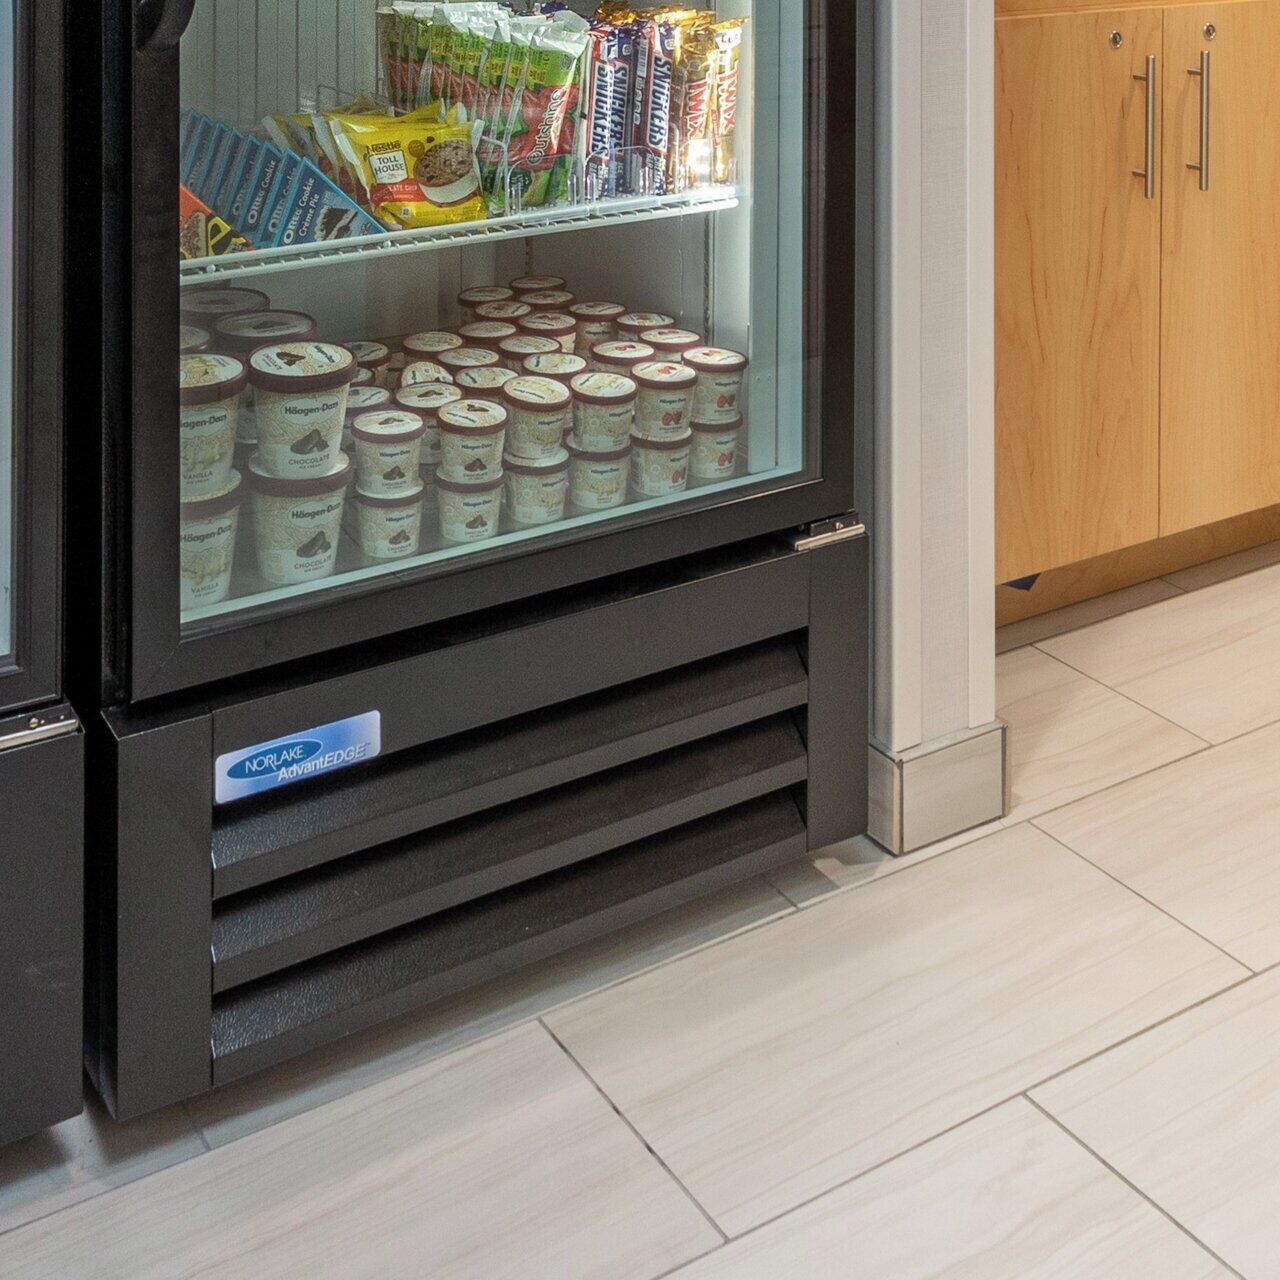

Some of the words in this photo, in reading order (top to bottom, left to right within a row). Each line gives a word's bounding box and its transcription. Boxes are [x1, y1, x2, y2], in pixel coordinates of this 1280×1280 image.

[589, 63, 610, 160] SNICKERS
[648, 55, 671, 148] SNICKERS
[686, 79, 708, 140] TWIX
[717, 61, 737, 135] TWIX
[526, 88, 561, 164] Outshine
[373, 162, 405, 175] HOUSE
[377, 155, 399, 165] TOLL
[283, 208, 301, 245] OREO
[299, 177, 315, 208] Cookie
[298, 210, 314, 237] Creme
[311, 193, 320, 210] Pie
[284, 401, 339, 416] Häagen-Dazs
[288, 453, 330, 466] CHOCOLATE
[182, 471, 213, 481] VANILLA
[291, 501, 341, 520] Häagen-Dazs
[293, 556, 332, 570] CHOCOLATE
[190, 582, 219, 595] VANILLA
[244, 743, 305, 774] NORLAKE
[277, 744, 368, 782] AdvantEDGE
